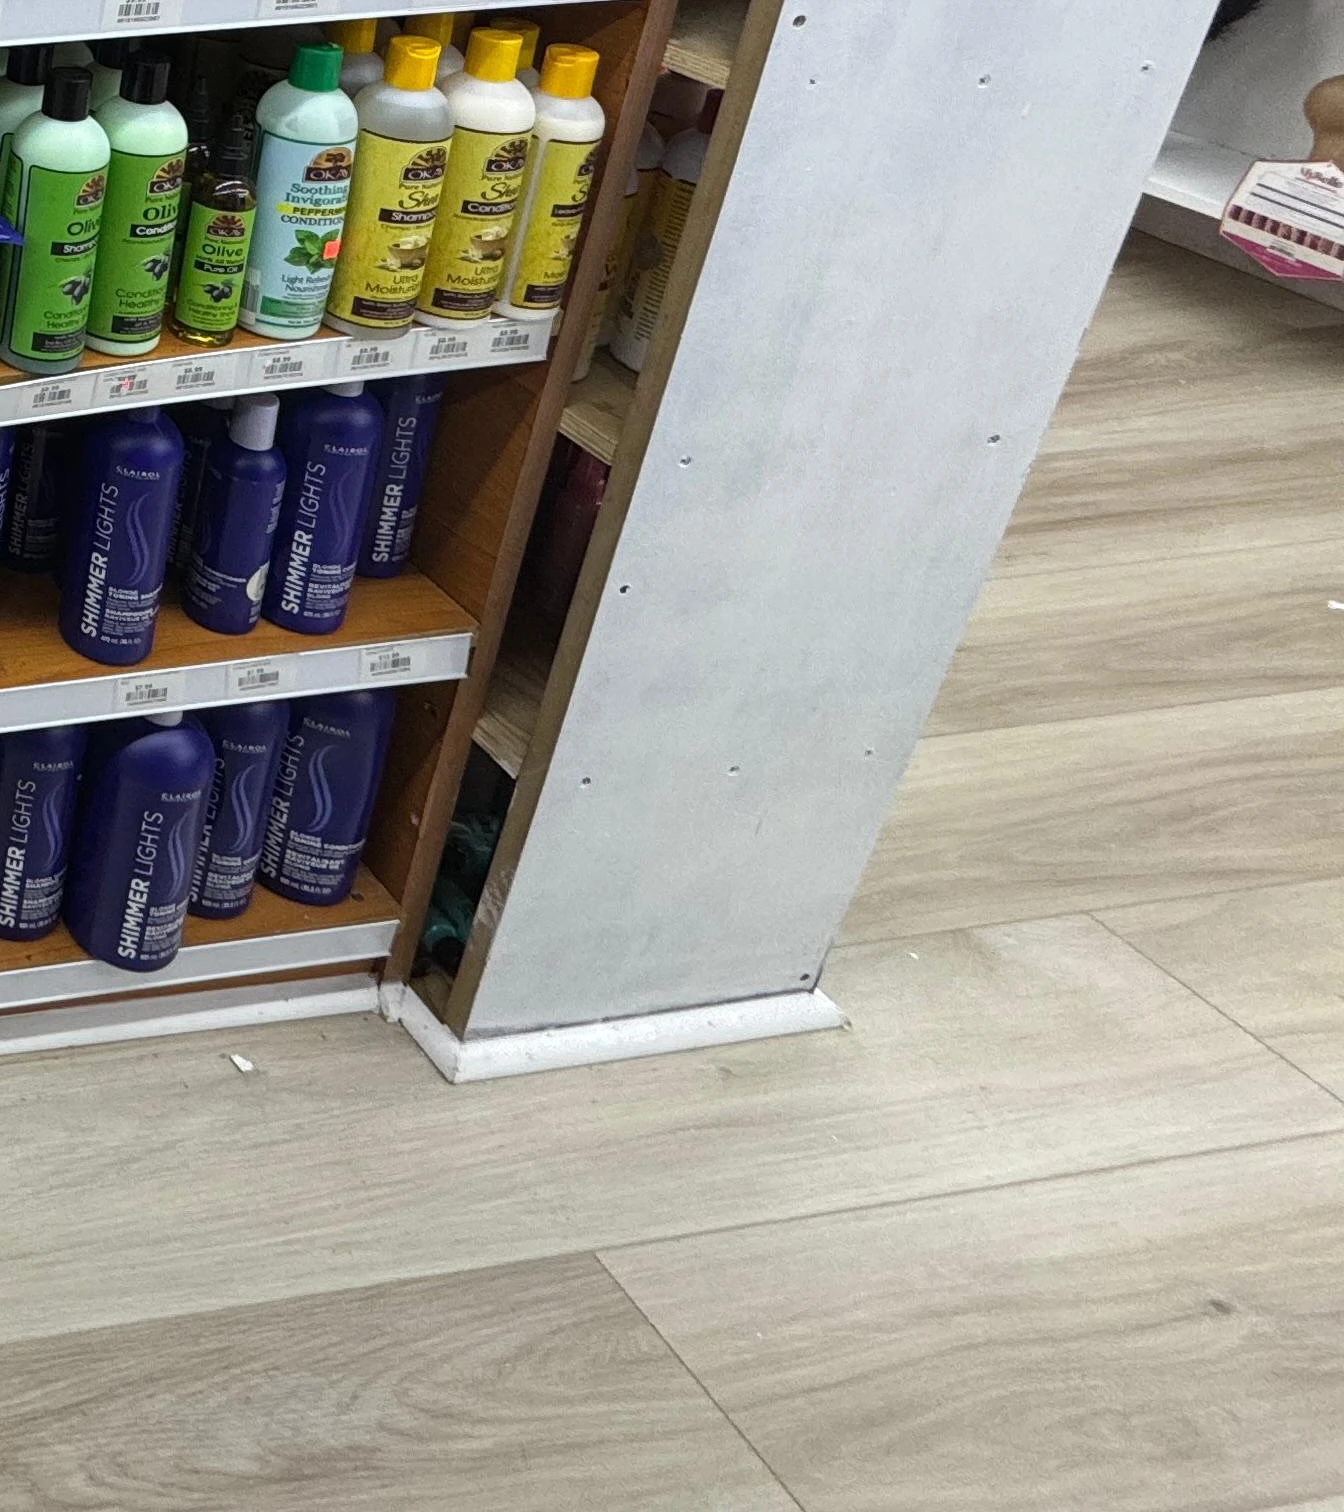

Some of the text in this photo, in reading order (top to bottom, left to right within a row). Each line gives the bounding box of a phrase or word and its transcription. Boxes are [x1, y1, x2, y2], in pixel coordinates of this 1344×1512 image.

[202, 243, 243, 258] Olive
[82, 484, 119, 636] SHIMMER LIGHTS
[283, 463, 326, 613] SHIMMER LIGHTS
[373, 417, 416, 561] SHIMMER LIGHTS
[11, 779, 36, 842] LIGHTS
[117, 812, 163, 959] SHIMMER LIGHTS
